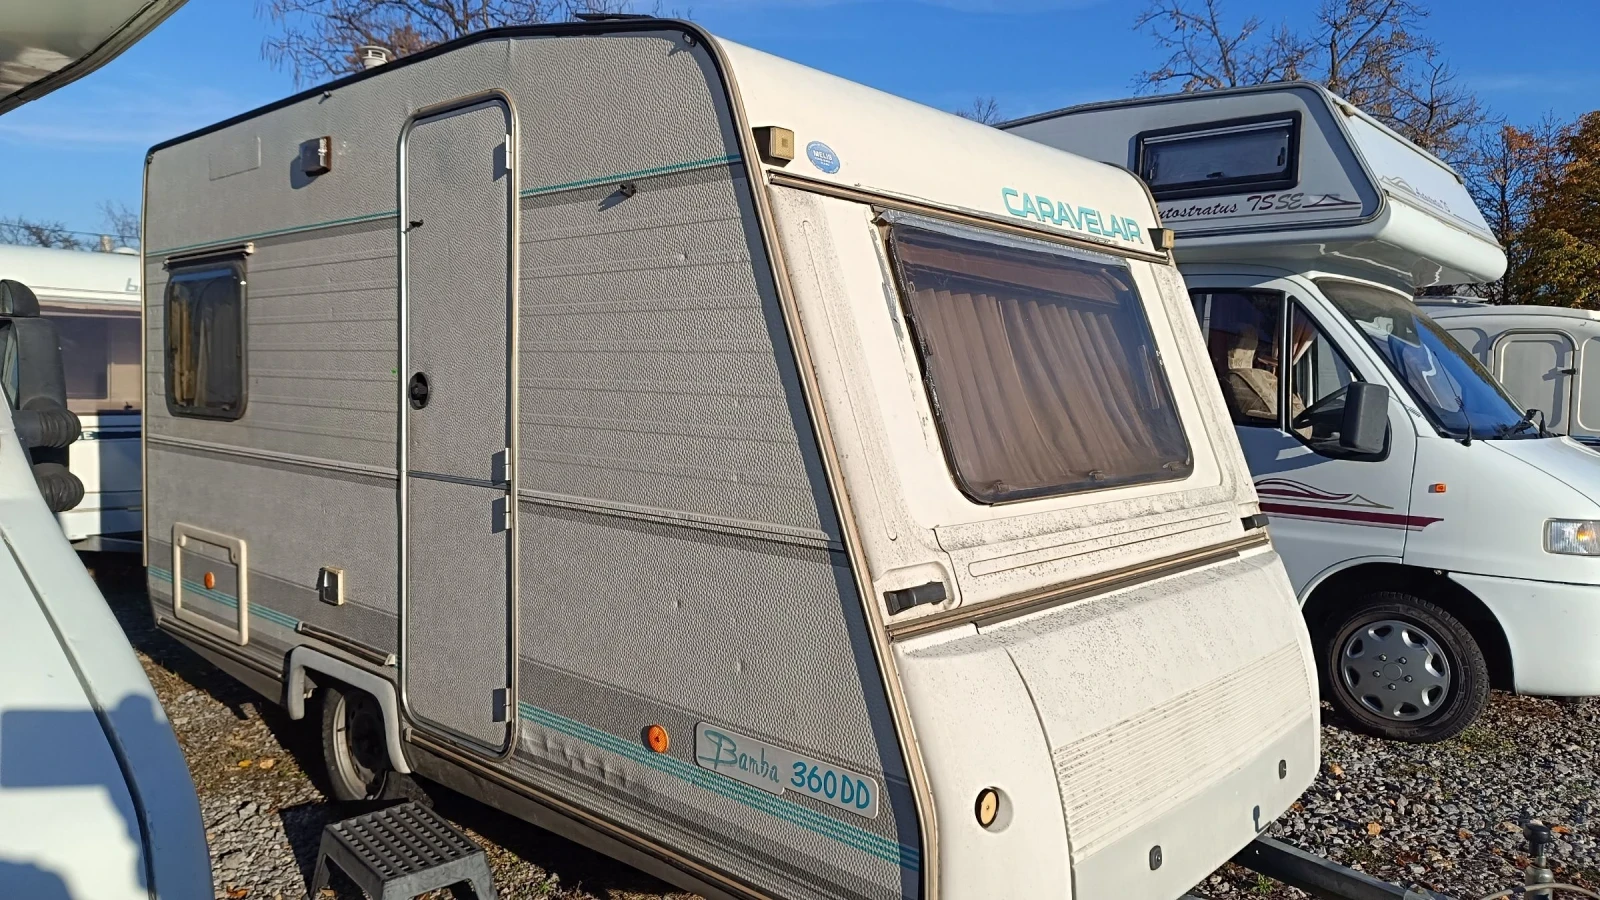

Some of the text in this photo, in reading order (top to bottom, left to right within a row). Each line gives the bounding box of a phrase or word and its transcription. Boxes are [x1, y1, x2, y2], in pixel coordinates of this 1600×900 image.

[1001, 187, 1144, 244] CARAVELAIR
[1157, 202, 1238, 219] utostratus
[698, 729, 780, 784] Bamba
